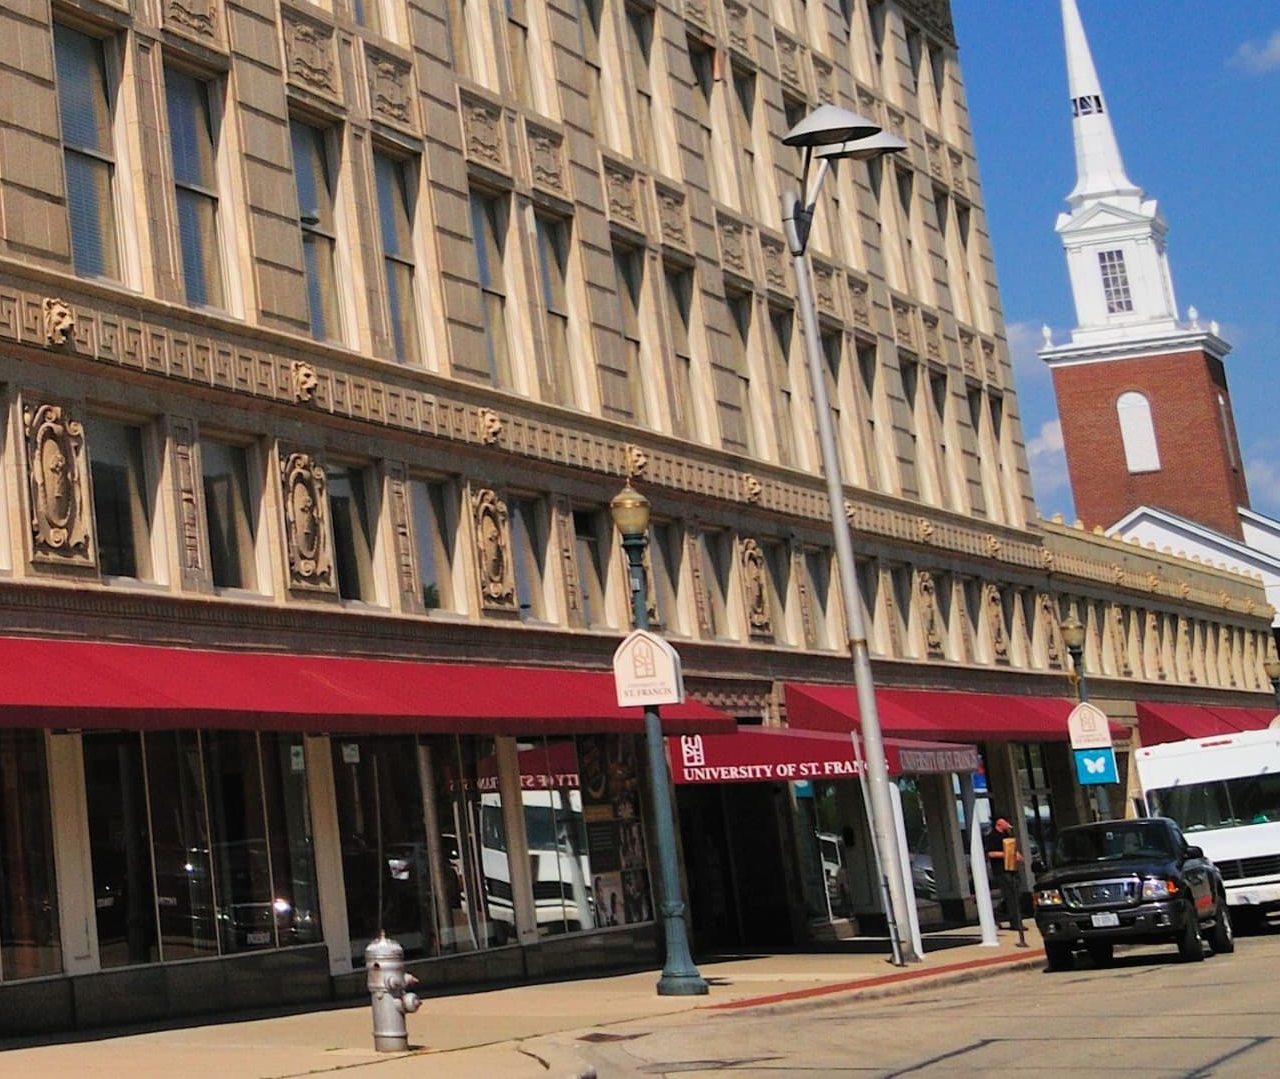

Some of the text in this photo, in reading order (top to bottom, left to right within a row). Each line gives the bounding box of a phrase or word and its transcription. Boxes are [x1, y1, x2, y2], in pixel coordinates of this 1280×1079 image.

[683, 764, 772, 781] UNIVERSITY
[776, 763, 796, 777] OF
[799, 762, 822, 776] ST.
